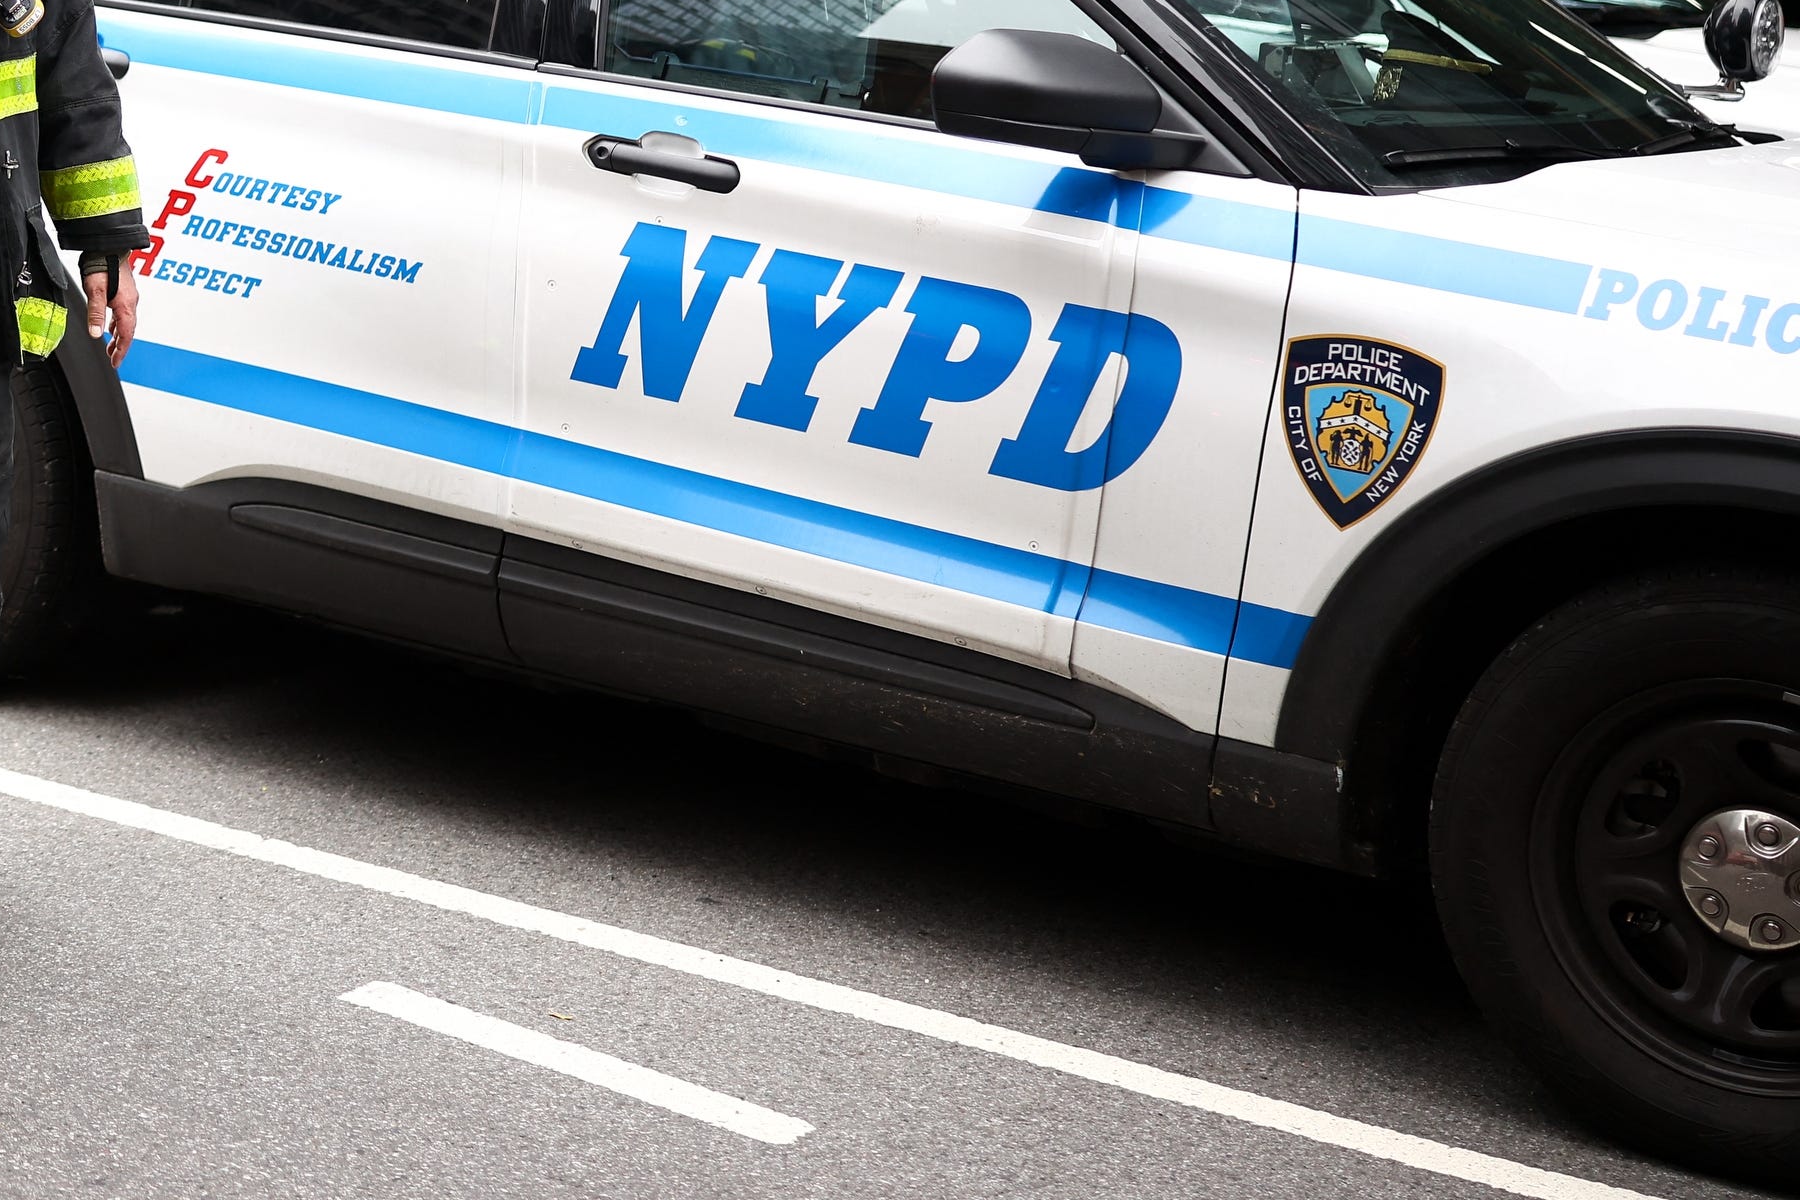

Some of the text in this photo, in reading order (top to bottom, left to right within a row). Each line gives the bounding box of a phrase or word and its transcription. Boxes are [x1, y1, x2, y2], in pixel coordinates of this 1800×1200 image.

[185, 148, 342, 214] COURTESY
[152, 189, 423, 284] PROFESSIONALISM
[1584, 267, 1800, 355] POLIC
[570, 221, 1183, 492] NYPD
[1294, 362, 1430, 406] DEPARTMENT
[1328, 343, 1403, 371] POLICE
[1288, 405, 1323, 482] CITY OF
[1366, 419, 1427, 503] NEW YORK
